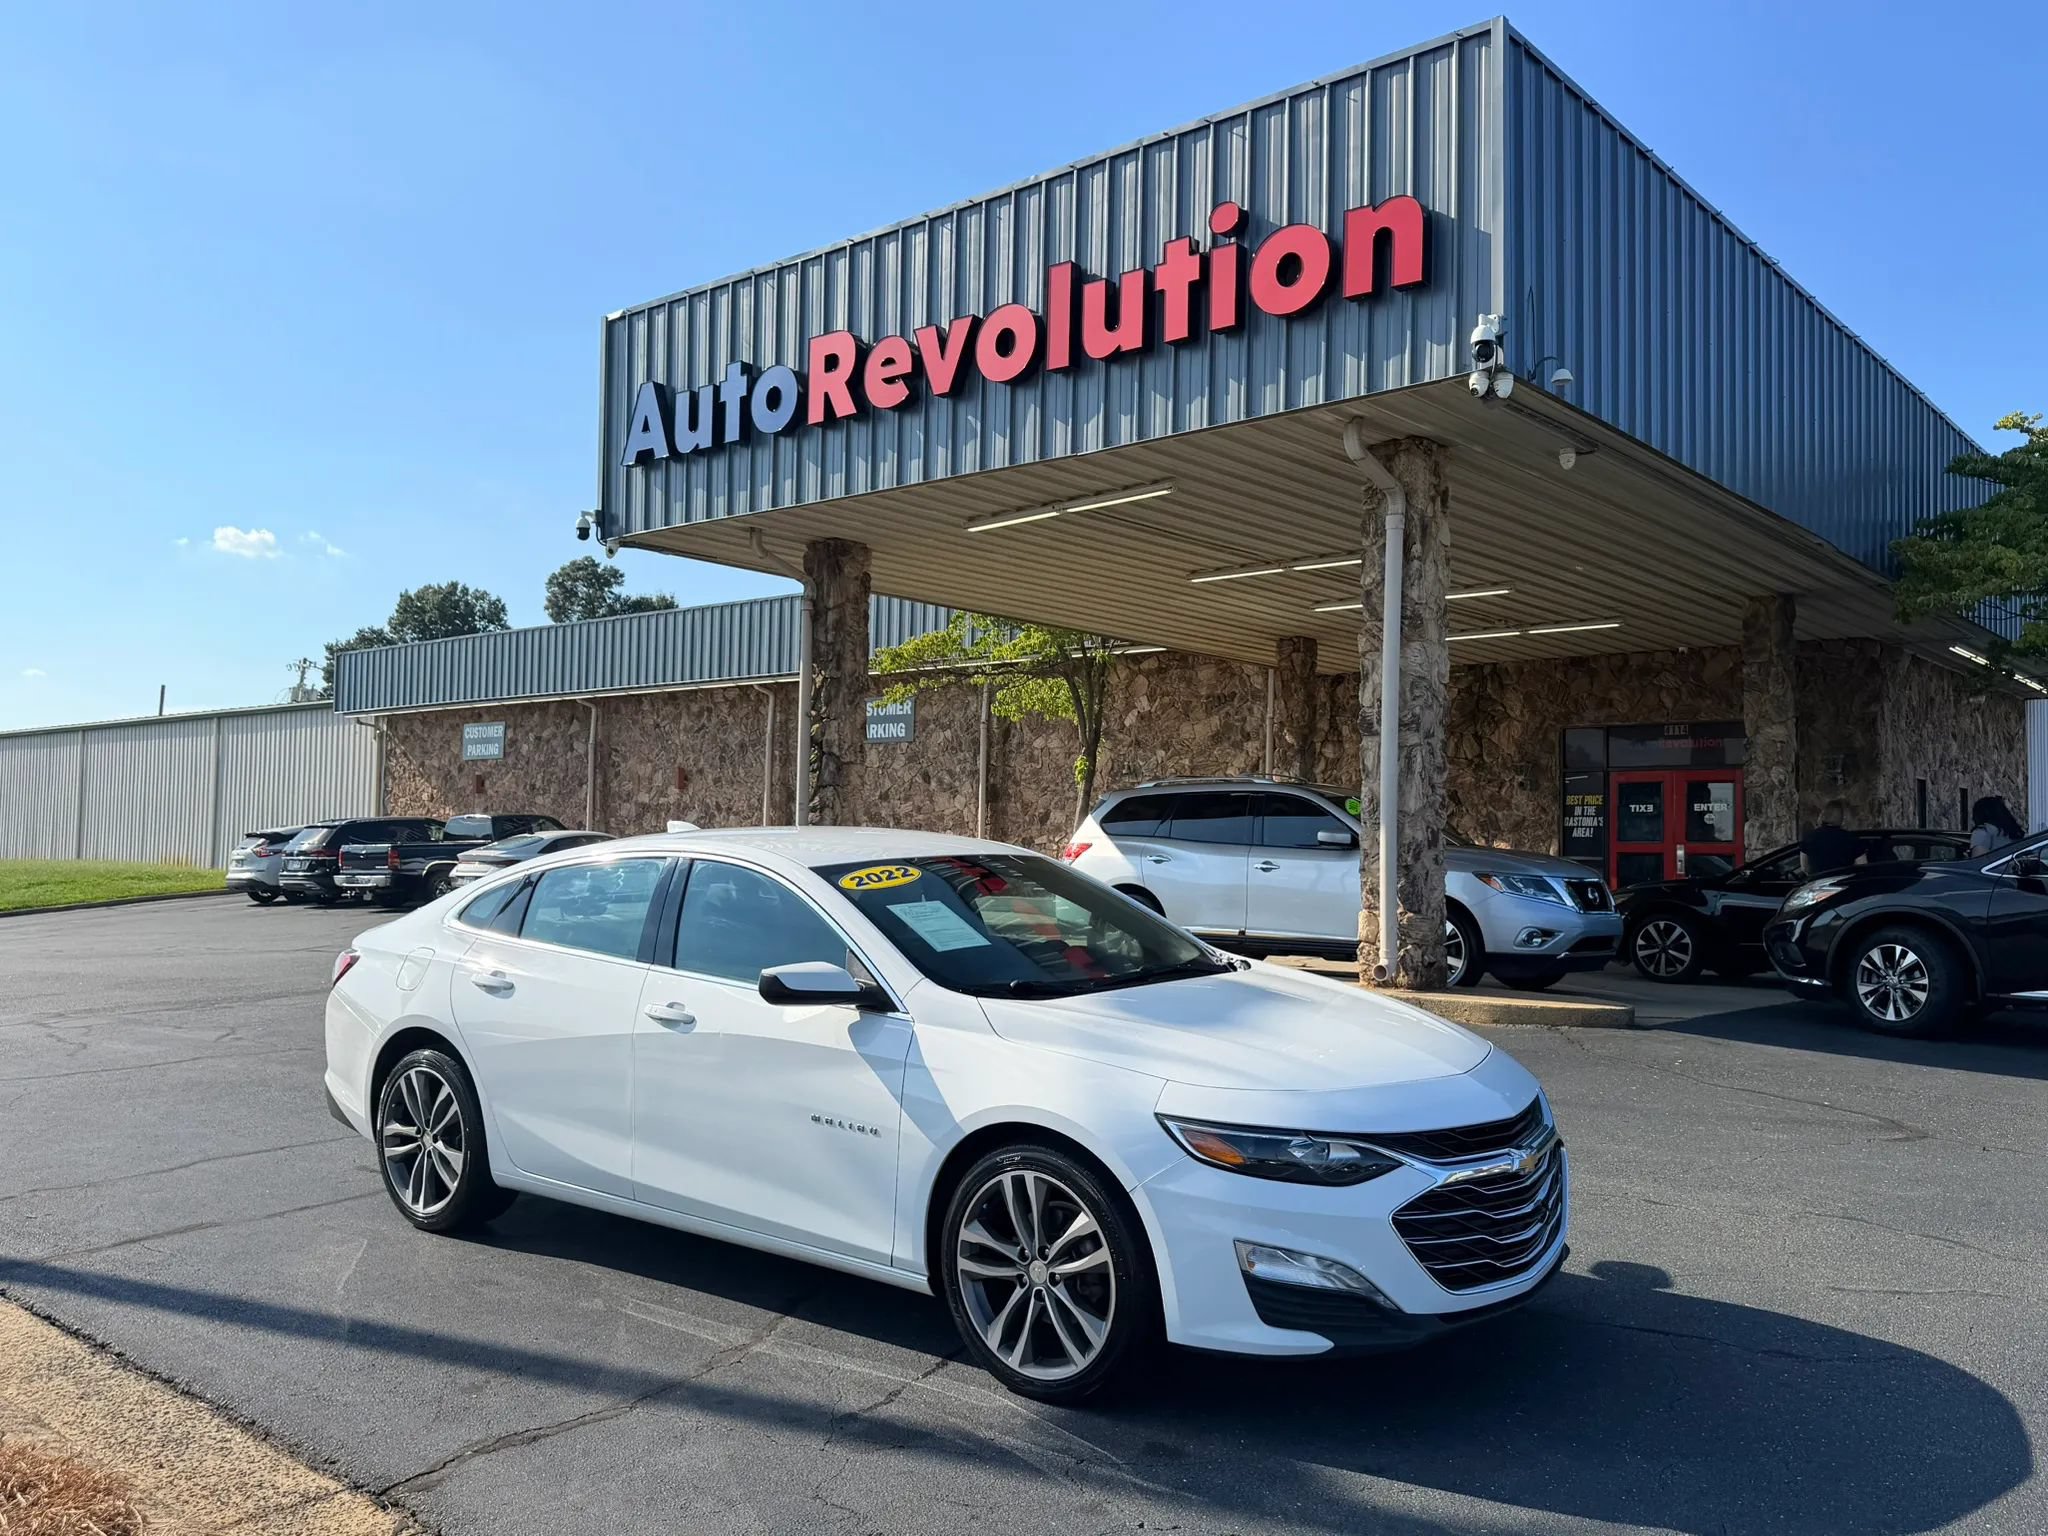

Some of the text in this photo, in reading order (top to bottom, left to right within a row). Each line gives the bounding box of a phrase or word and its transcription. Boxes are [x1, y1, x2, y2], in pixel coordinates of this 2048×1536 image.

[621, 195, 1431, 467] AutoRevolution
[866, 700, 912, 717] STOMER
[464, 725, 504, 739] CUSTOMER
[866, 723, 906, 738] RKING
[467, 743, 499, 756] PARKING
[1566, 795, 1604, 806] BEST PRICE
[1693, 803, 1728, 811] ENTER
[1574, 806, 1597, 816] IN THE
[1572, 828, 1594, 838] AREA!
[849, 867, 916, 888] 2022
